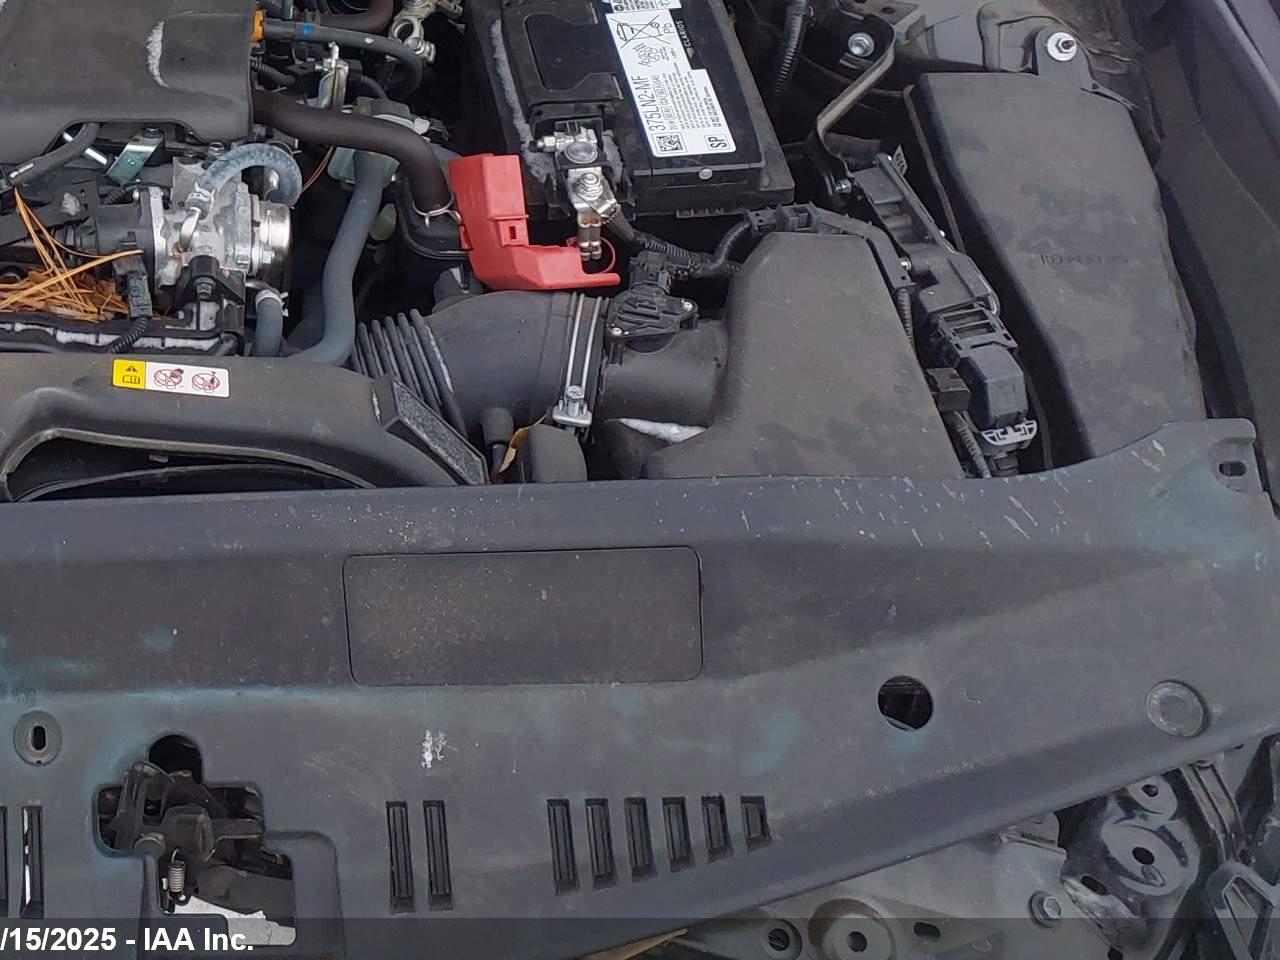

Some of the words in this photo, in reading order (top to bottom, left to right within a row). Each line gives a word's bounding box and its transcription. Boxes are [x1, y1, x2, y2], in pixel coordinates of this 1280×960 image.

[663, 22, 675, 34] Pb
[676, 20, 691, 47] CLARIOS
[631, 74, 666, 131] 375LN2-MF
[707, 136, 727, 150] SP
